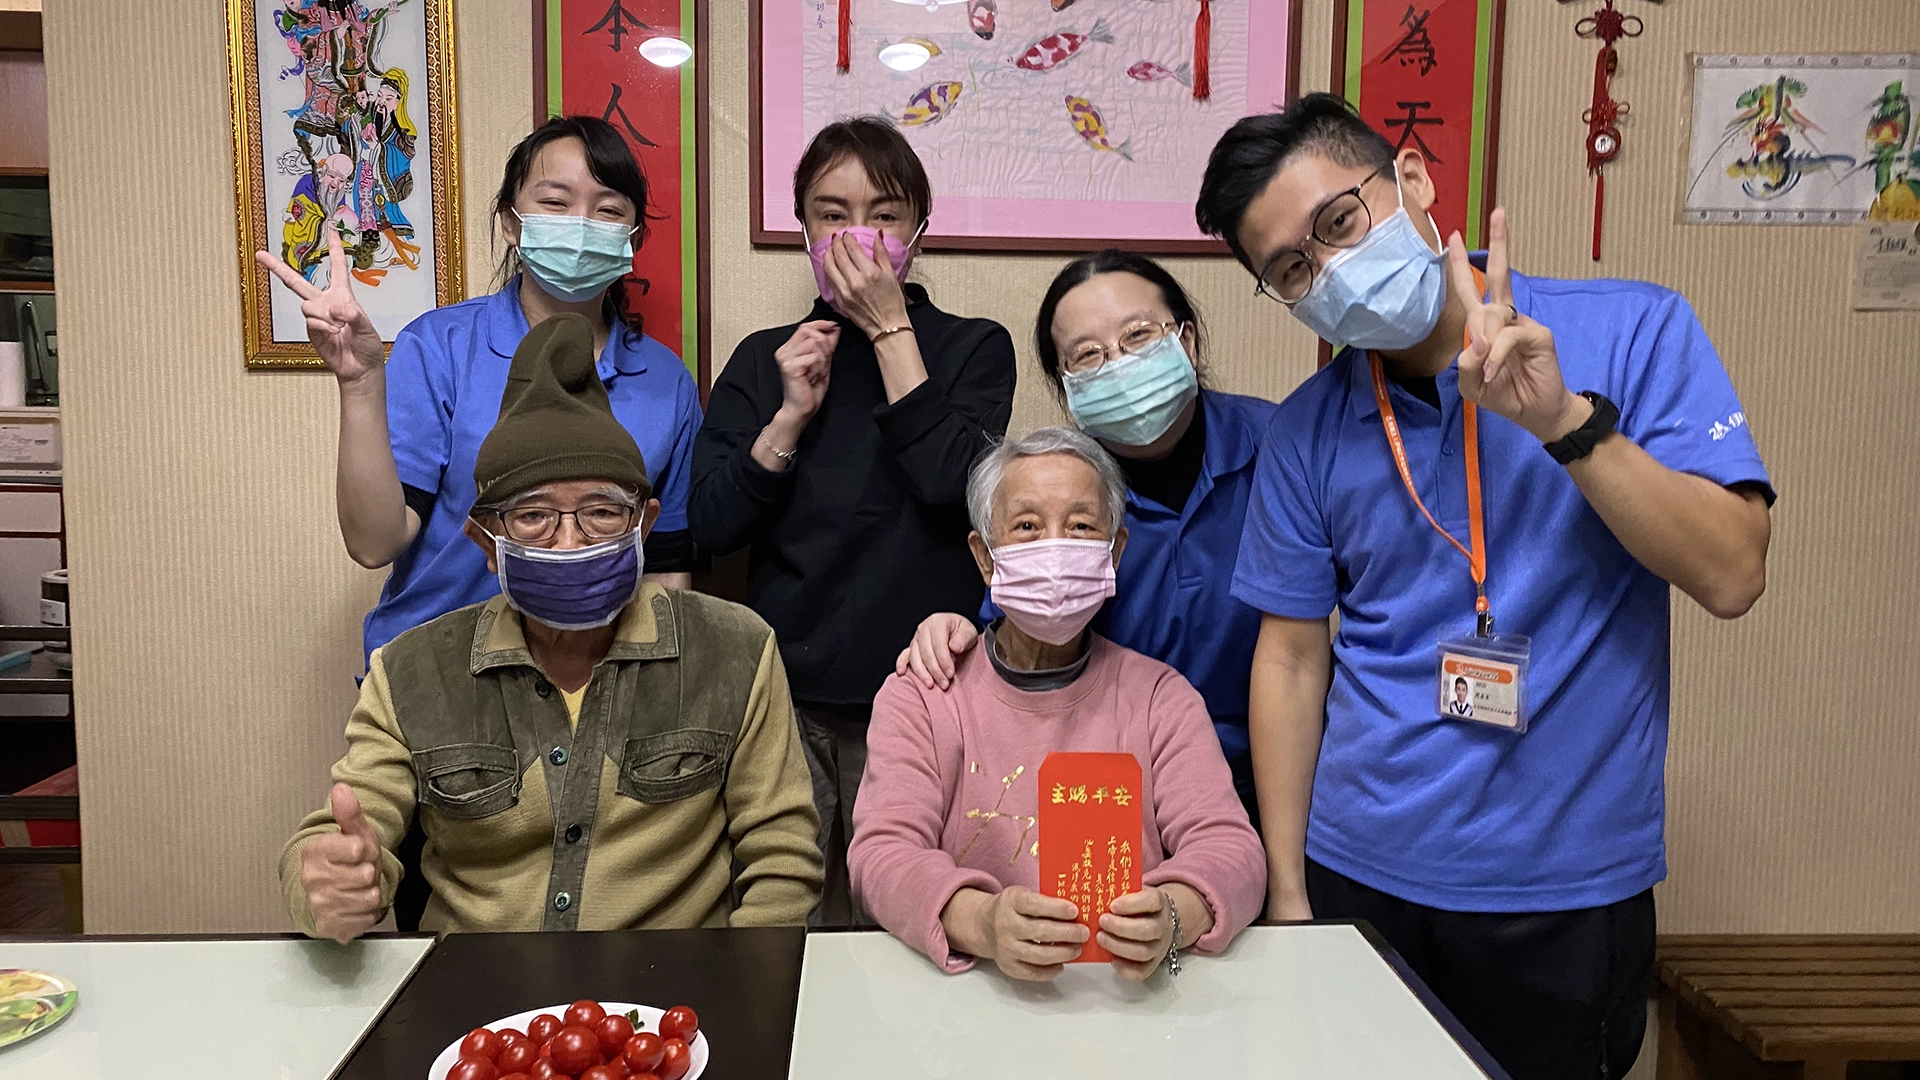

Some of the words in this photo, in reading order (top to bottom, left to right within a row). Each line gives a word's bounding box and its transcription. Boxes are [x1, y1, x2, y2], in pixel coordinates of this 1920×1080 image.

[1380, 4, 1445, 204] 為天
[1051, 782, 1133, 806] 主賜平安
[1105, 836, 1118, 906] 上帝是信實
